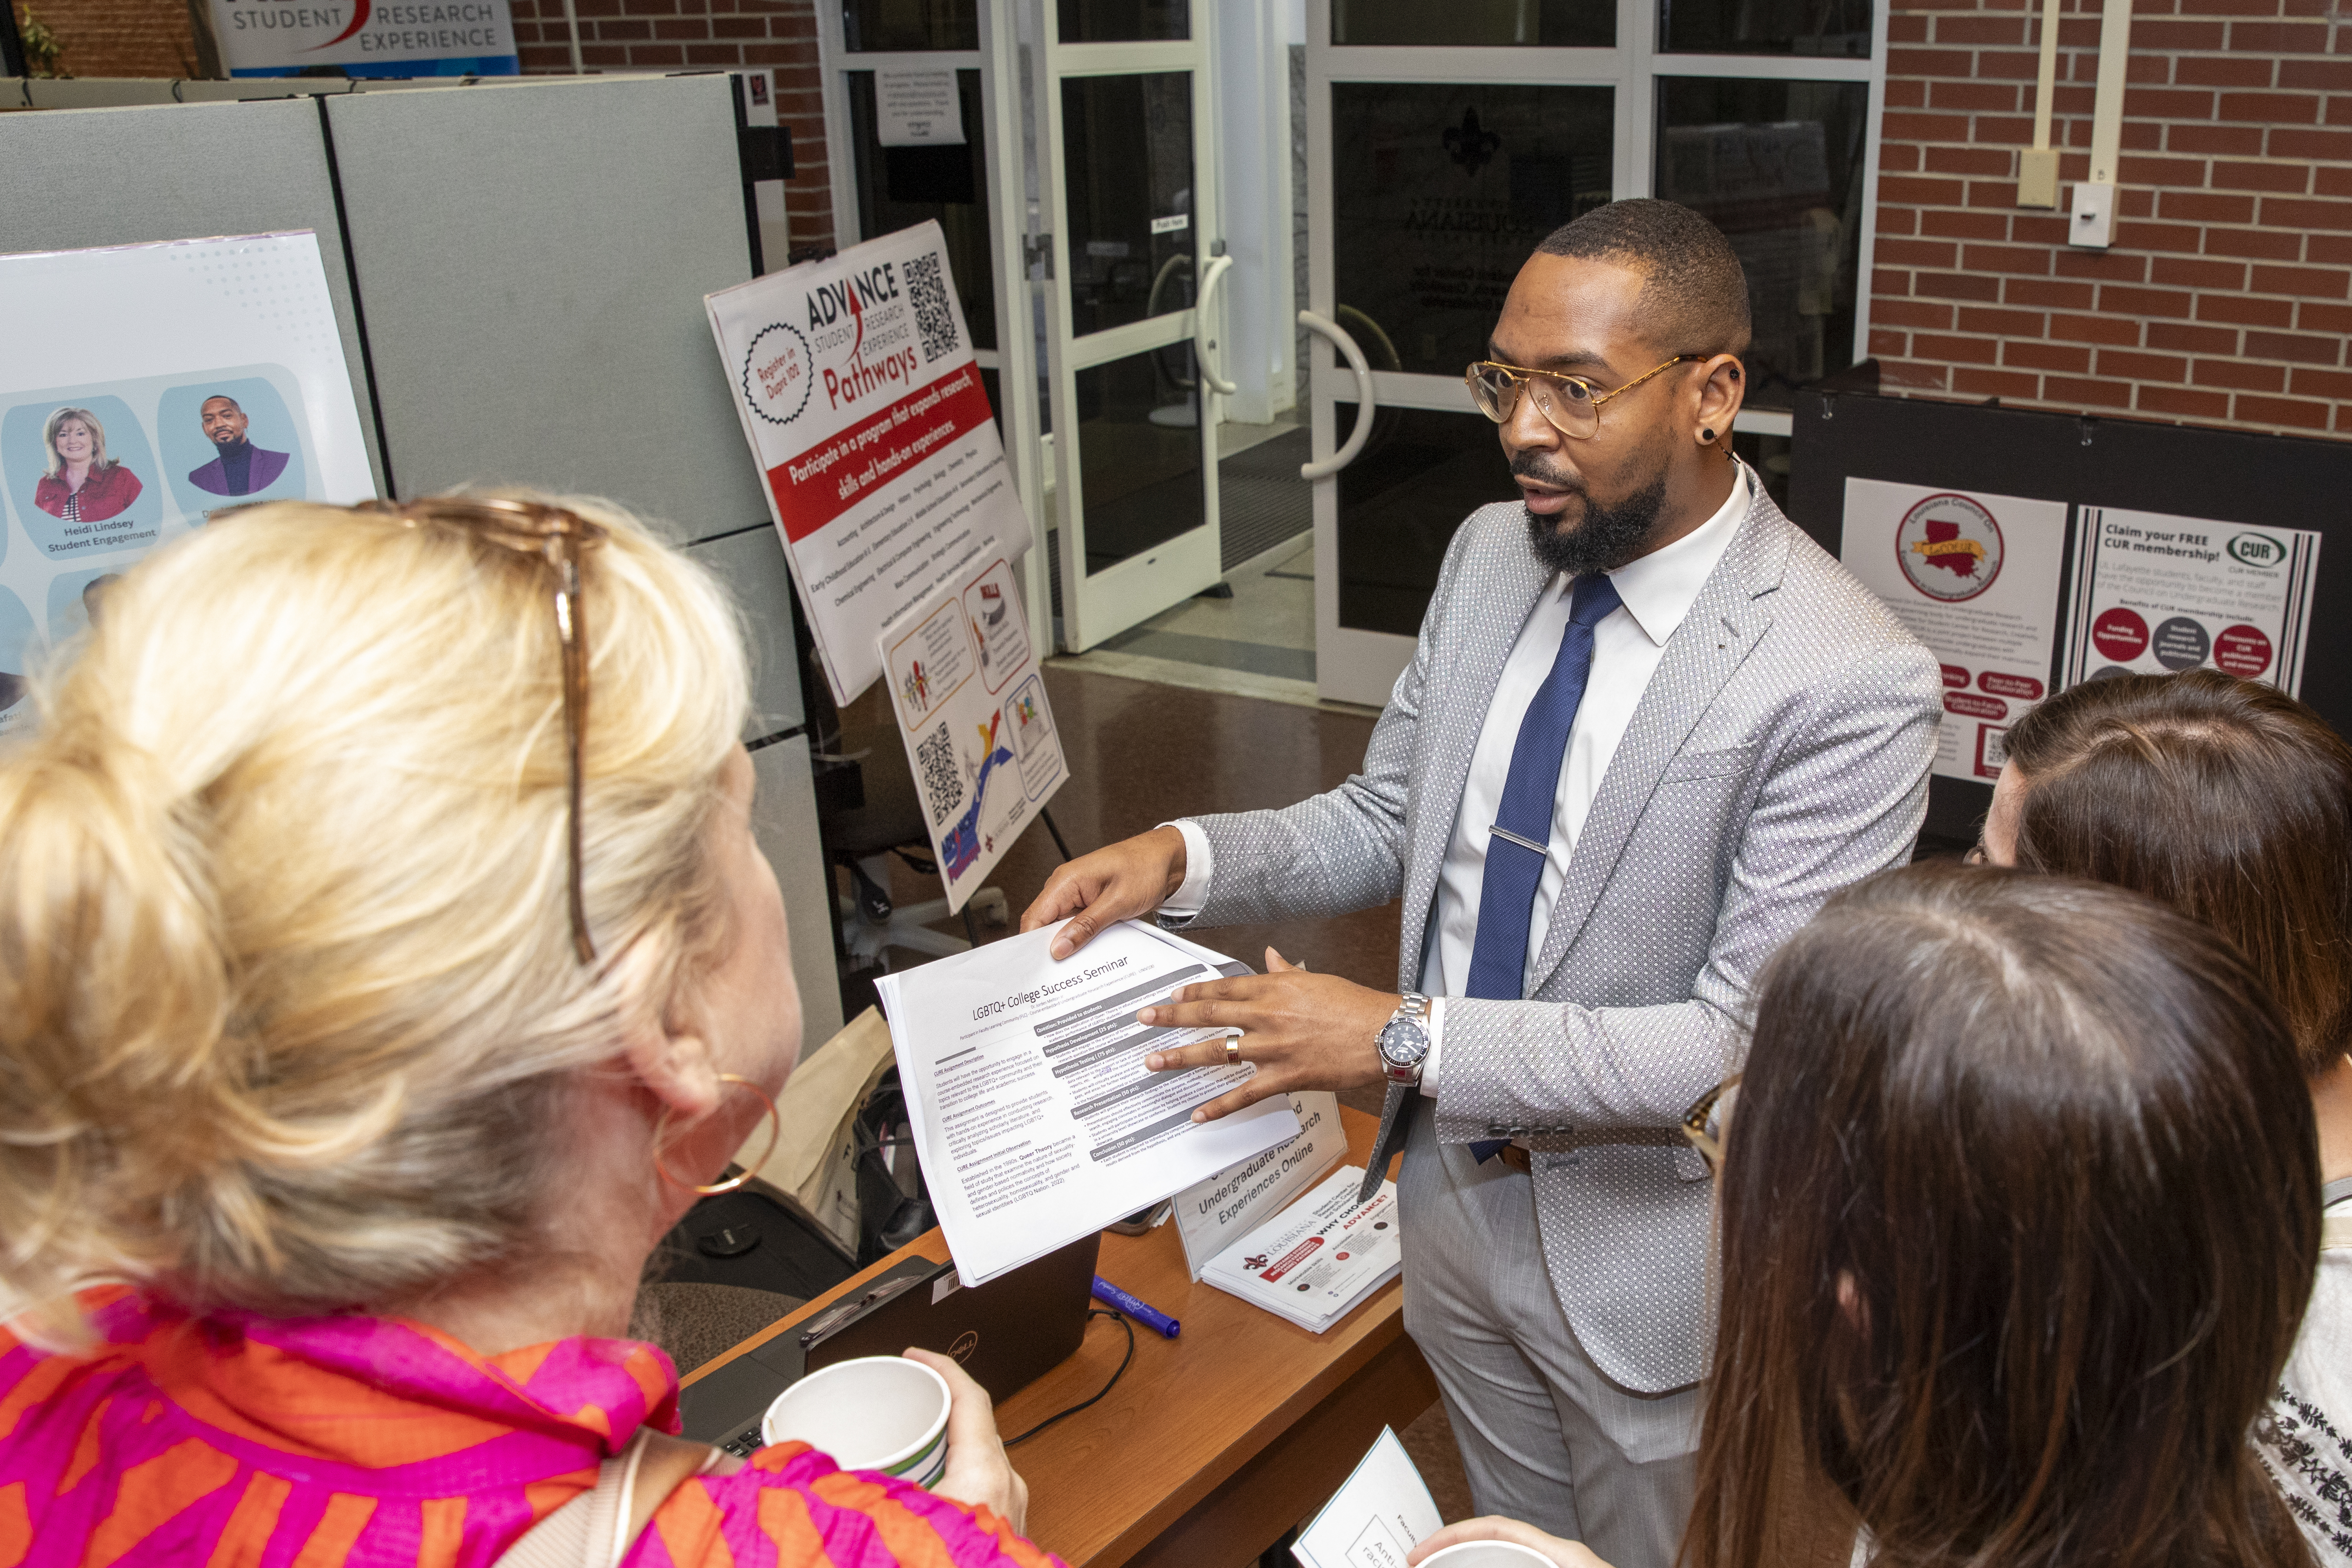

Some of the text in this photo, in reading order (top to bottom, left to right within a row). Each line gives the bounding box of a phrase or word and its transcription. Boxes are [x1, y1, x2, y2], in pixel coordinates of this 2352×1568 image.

[233, 5, 493, 29] STUDENT RESEARCH
[360, 28, 496, 51] EXPERIENCE
[807, 263, 899, 331] ADVANCE
[814, 304, 904, 353] STUDENT RESEARCH
[862, 322, 910, 356] EXPERIENCE
[757, 347, 796, 382] Register in
[786, 363, 800, 381] 102
[823, 346, 917, 410] Pathways
[789, 447, 840, 486] Participate
[837, 440, 850, 456] in
[849, 438, 857, 451] a
[856, 418, 893, 451] program
[891, 405, 910, 426] that
[910, 386, 942, 416] expands
[838, 473, 860, 500] skills
[859, 461, 876, 487] and
[874, 448, 913, 476] hands-on
[48, 529, 156, 552] Student Engagement
[64, 521, 134, 536] Heidi Lindsey
[2106, 524, 2209, 546] Claim your FREE
[2104, 538, 2219, 562] CUR membership!
[2241, 541, 2270, 559] CUR
[2097, 570, 2116, 579] have
[2117, 573, 2133, 582] the
[2135, 575, 2186, 591] opportunity
[2187, 583, 2197, 591] to
[2199, 584, 2235, 597] become
[2244, 590, 2282, 602] member
[2112, 562, 2151, 575] Lafayette
[2227, 578, 2244, 587] and
[2097, 580, 2106, 589] of
[2107, 581, 2122, 591] the
[2123, 584, 2153, 596] Council
[2169, 590, 2235, 607] Undergraduate
[2119, 599, 2149, 608] Benefits
[2177, 606, 2223, 620] membership
[2096, 630, 2142, 645] Opportunities
[2107, 624, 2134, 635] Funding
[2167, 633, 2196, 643] research
[2170, 624, 2197, 635] Student
[2222, 633, 2257, 644] Discounts
[2158, 641, 2187, 652] journals
[2159, 649, 2201, 661] publications
[2222, 650, 2264, 663] publications
[2236, 644, 2252, 653] CUR
[973, 957, 1127, 1020] LGBTQ+ College Success Seminar
[1036, 1023, 1058, 1034] Question:
[1057, 1014, 1077, 1025] Provided
[1082, 1005, 1102, 1015] students
[1045, 1041, 1069, 1053] Hypothesis
[1069, 1030, 1099, 1044] Development
[1106, 1022, 1117, 1030] pts):
[936, 1079, 953, 1088] Students
[978, 1061, 1000, 1072] opportunity
[1006, 1053, 1022, 1062] engage
[944, 1061, 964, 1072] Assignment
[964, 1055, 983, 1065] Description
[1054, 1062, 1079, 1074] Hypothesis
[1078, 1055, 1095, 1065] Testing
[1105, 1047, 1117, 1055] pts):
[937, 1078, 972, 1095] course-embedded
[973, 1072, 990, 1082] research
[991, 1064, 1014, 1075] experience
[1015, 1057, 1032, 1066] focused
[953, 1107, 975, 1118] Assignment
[975, 1100, 995, 1109] Outcomes
[1073, 1105, 1094, 1118] Research
[1093, 1094, 1121, 1108] Presentation
[1129, 1085, 1140, 1094] pts):
[969, 1154, 993, 1167] Assignment
[993, 1149, 1006, 1157] Initial
[1006, 1140, 1031, 1152] Observation
[1091, 1145, 1117, 1159] Conclusion
[1124, 1136, 1135, 1145] pts):
[1199, 1150, 1275, 1215] Undergraduate
[1218, 1142, 1313, 1225] Experiences Online
[1313, 1199, 1333, 1216] Student
[1332, 1187, 1348, 1202] Center
[1343, 1194, 1387, 1230] ADVANCE?
[1267, 1220, 1316, 1256] LOUISIANA
[1316, 1219, 1339, 1235] WHY
[1397, 1514, 1417, 1548] Faculty
